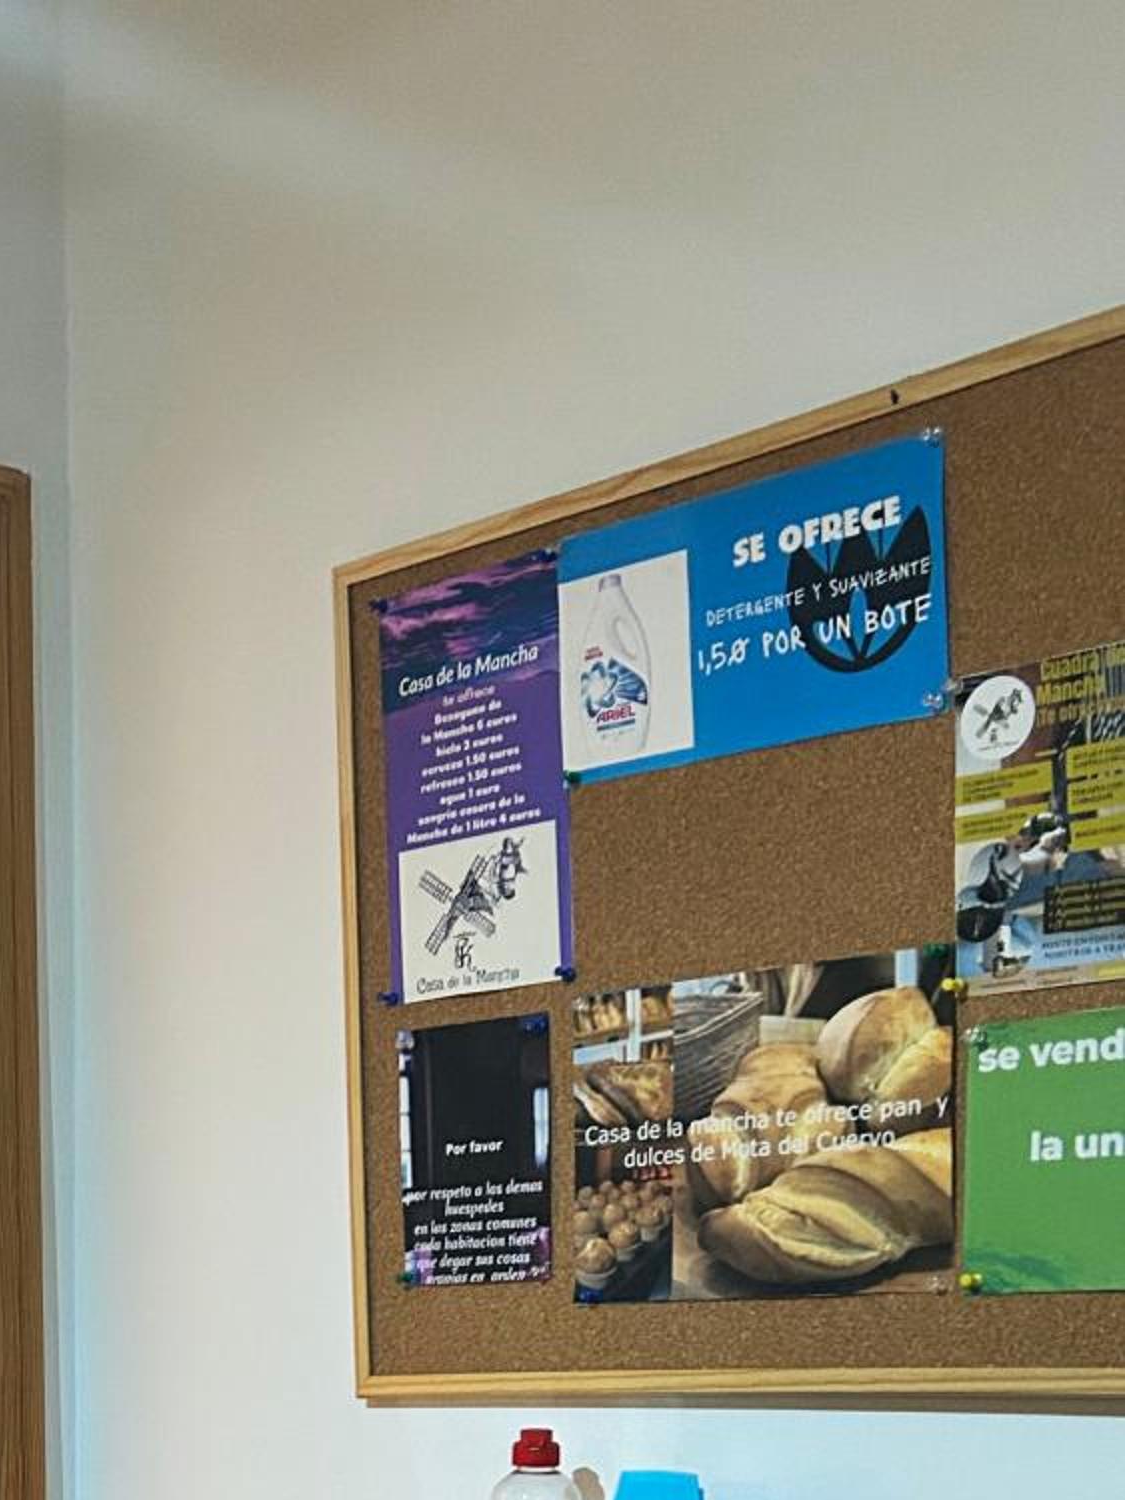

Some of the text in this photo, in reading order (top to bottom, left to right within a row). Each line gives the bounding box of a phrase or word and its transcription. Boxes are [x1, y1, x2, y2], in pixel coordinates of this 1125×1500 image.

[733, 495, 902, 567] SE OFRECE
[706, 555, 930, 627] DETERGENTE Y SUAVIZANTE
[762, 624, 806, 658] POR
[818, 614, 851, 643] UN
[864, 593, 932, 634] BOTE
[398, 643, 539, 697] Casa de la Mancha
[488, 746, 520, 760] euros
[490, 762, 522, 776] euros
[978, 1045, 1020, 1073] se
[584, 1096, 949, 1146] Casa de la mancha te ofrece pan y
[445, 1140, 504, 1157] Por favor
[624, 1130, 896, 1168] dulces de Mota del Cuervo
[1030, 1131, 1064, 1161] la
[430, 1186, 472, 1202] respeto
[474, 1186, 483, 1197] a
[445, 1198, 504, 1218] huespedes
[414, 1224, 428, 1235] en
[449, 1221, 482, 1233] zonas
[486, 1217, 537, 1230] comunes
[444, 1234, 506, 1250] habitacion
[496, 1253, 531, 1265] cosas
